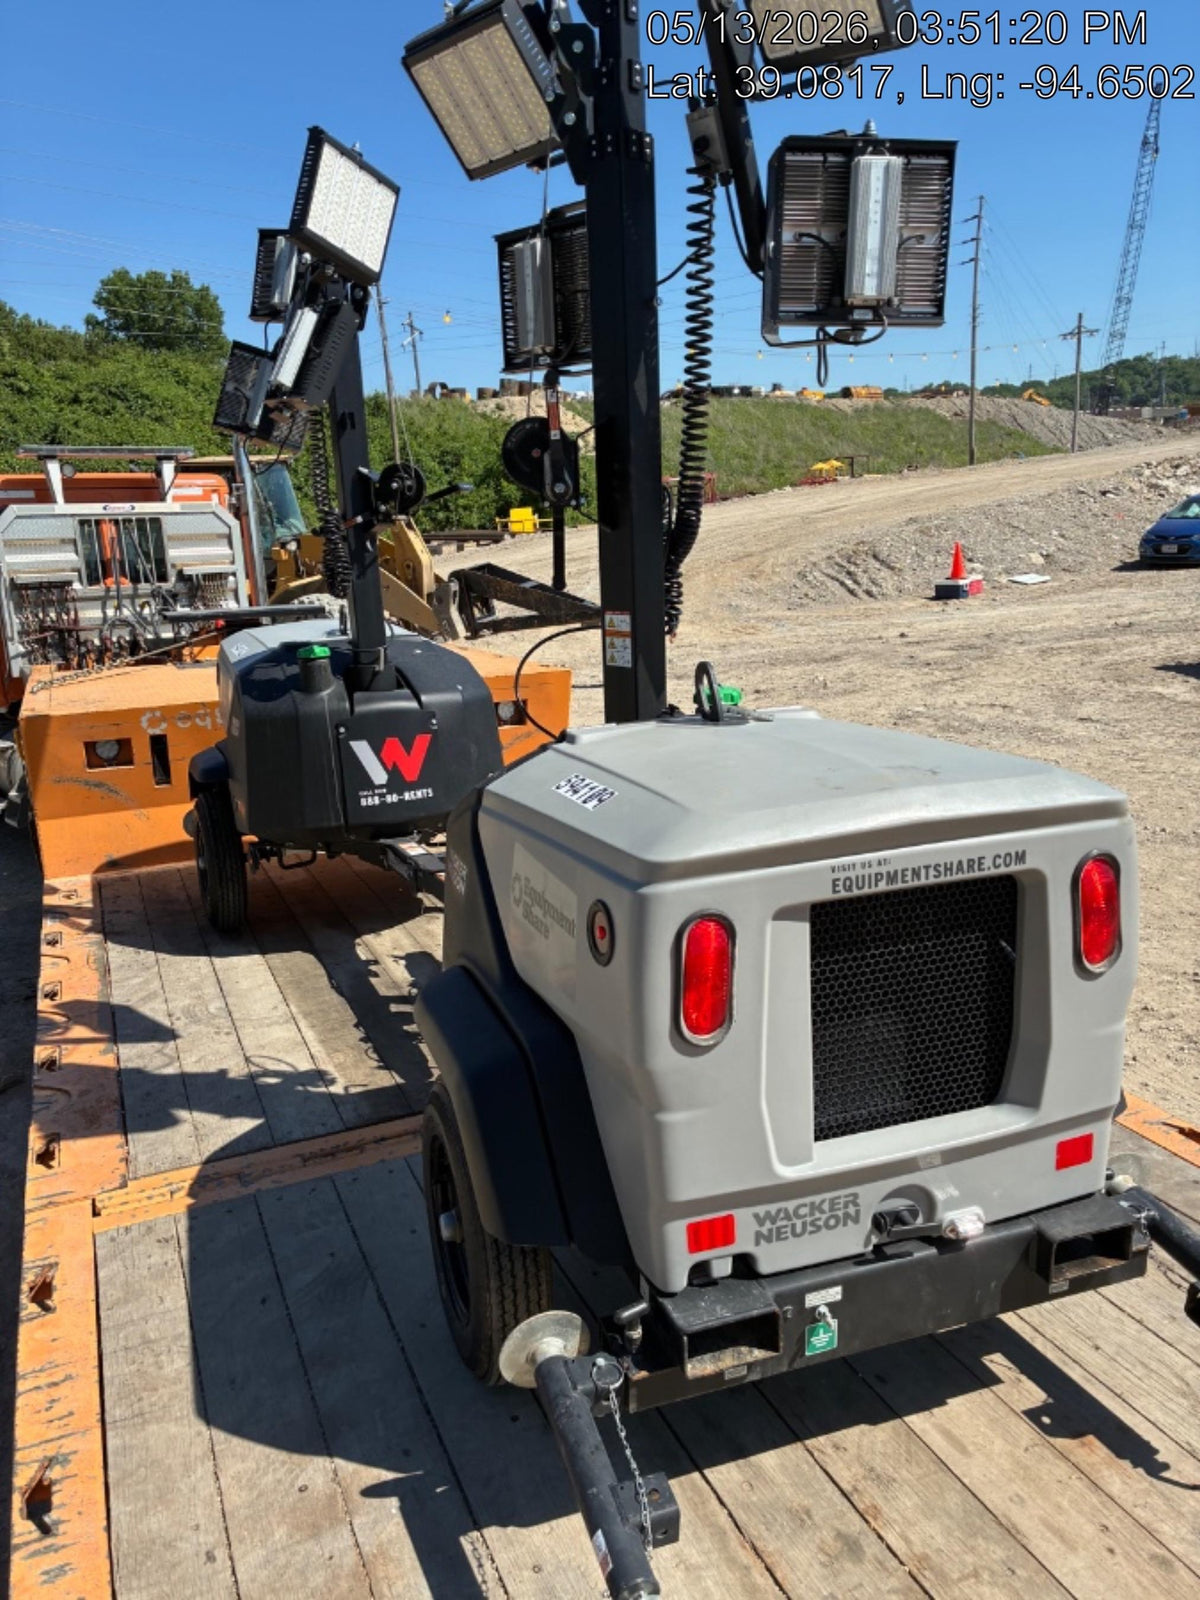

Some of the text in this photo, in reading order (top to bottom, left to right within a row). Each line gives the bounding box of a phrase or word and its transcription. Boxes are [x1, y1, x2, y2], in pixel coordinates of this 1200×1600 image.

[831, 862, 857, 874] VISIT
[860, 859, 873, 870] US
[831, 849, 1027, 895] EQUIPMENTSHARE.COM
[522, 899, 551, 941] Share
[523, 876, 576, 938] Equipment
[752, 1192, 861, 1228] WACKER
[754, 1208, 861, 1248] NEUSON
